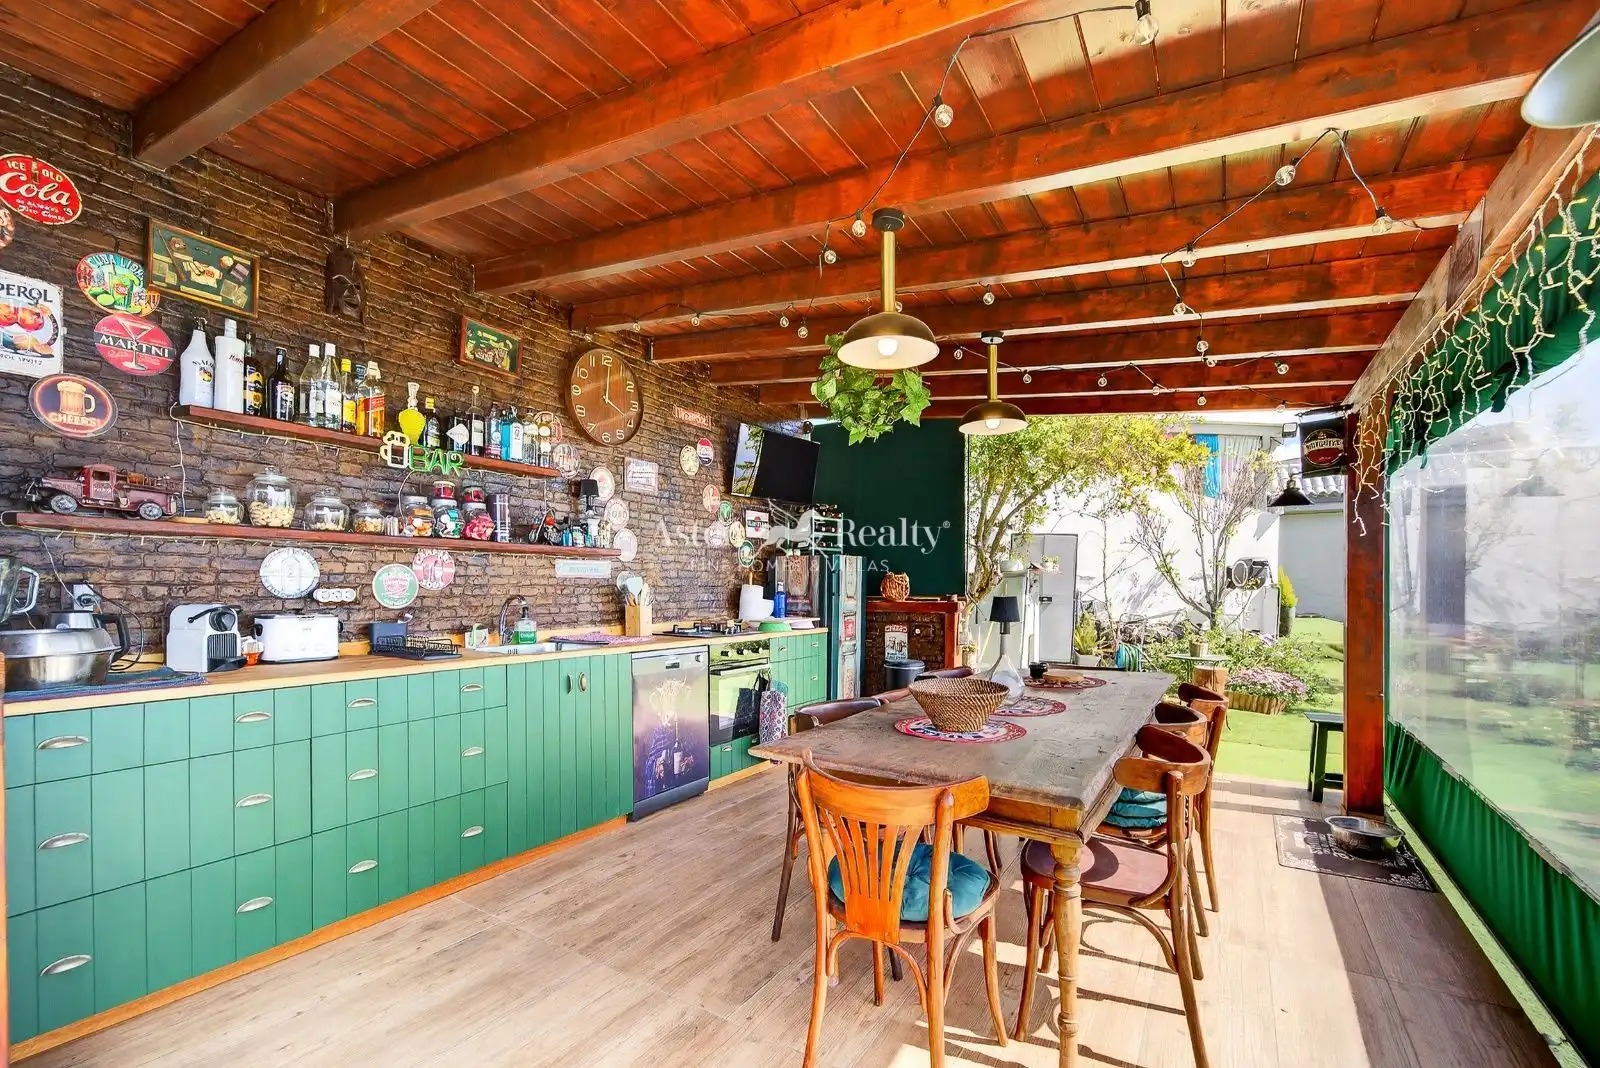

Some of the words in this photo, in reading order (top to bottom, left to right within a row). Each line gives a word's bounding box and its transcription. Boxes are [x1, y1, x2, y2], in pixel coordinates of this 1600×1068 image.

[6, 160, 26, 171] ICE
[0, 172, 71, 206] Cola
[602, 354, 613, 366] 12
[576, 365, 588, 379] 10
[571, 384, 582, 396] 9
[626, 381, 634, 392] 2
[576, 405, 586, 417] 8
[630, 400, 639, 412] 3
[586, 422, 597, 433] 7
[626, 418, 634, 428] 4
[601, 432, 611, 443] 6
[616, 429, 625, 440] 5
[408, 445, 464, 477] BAR
